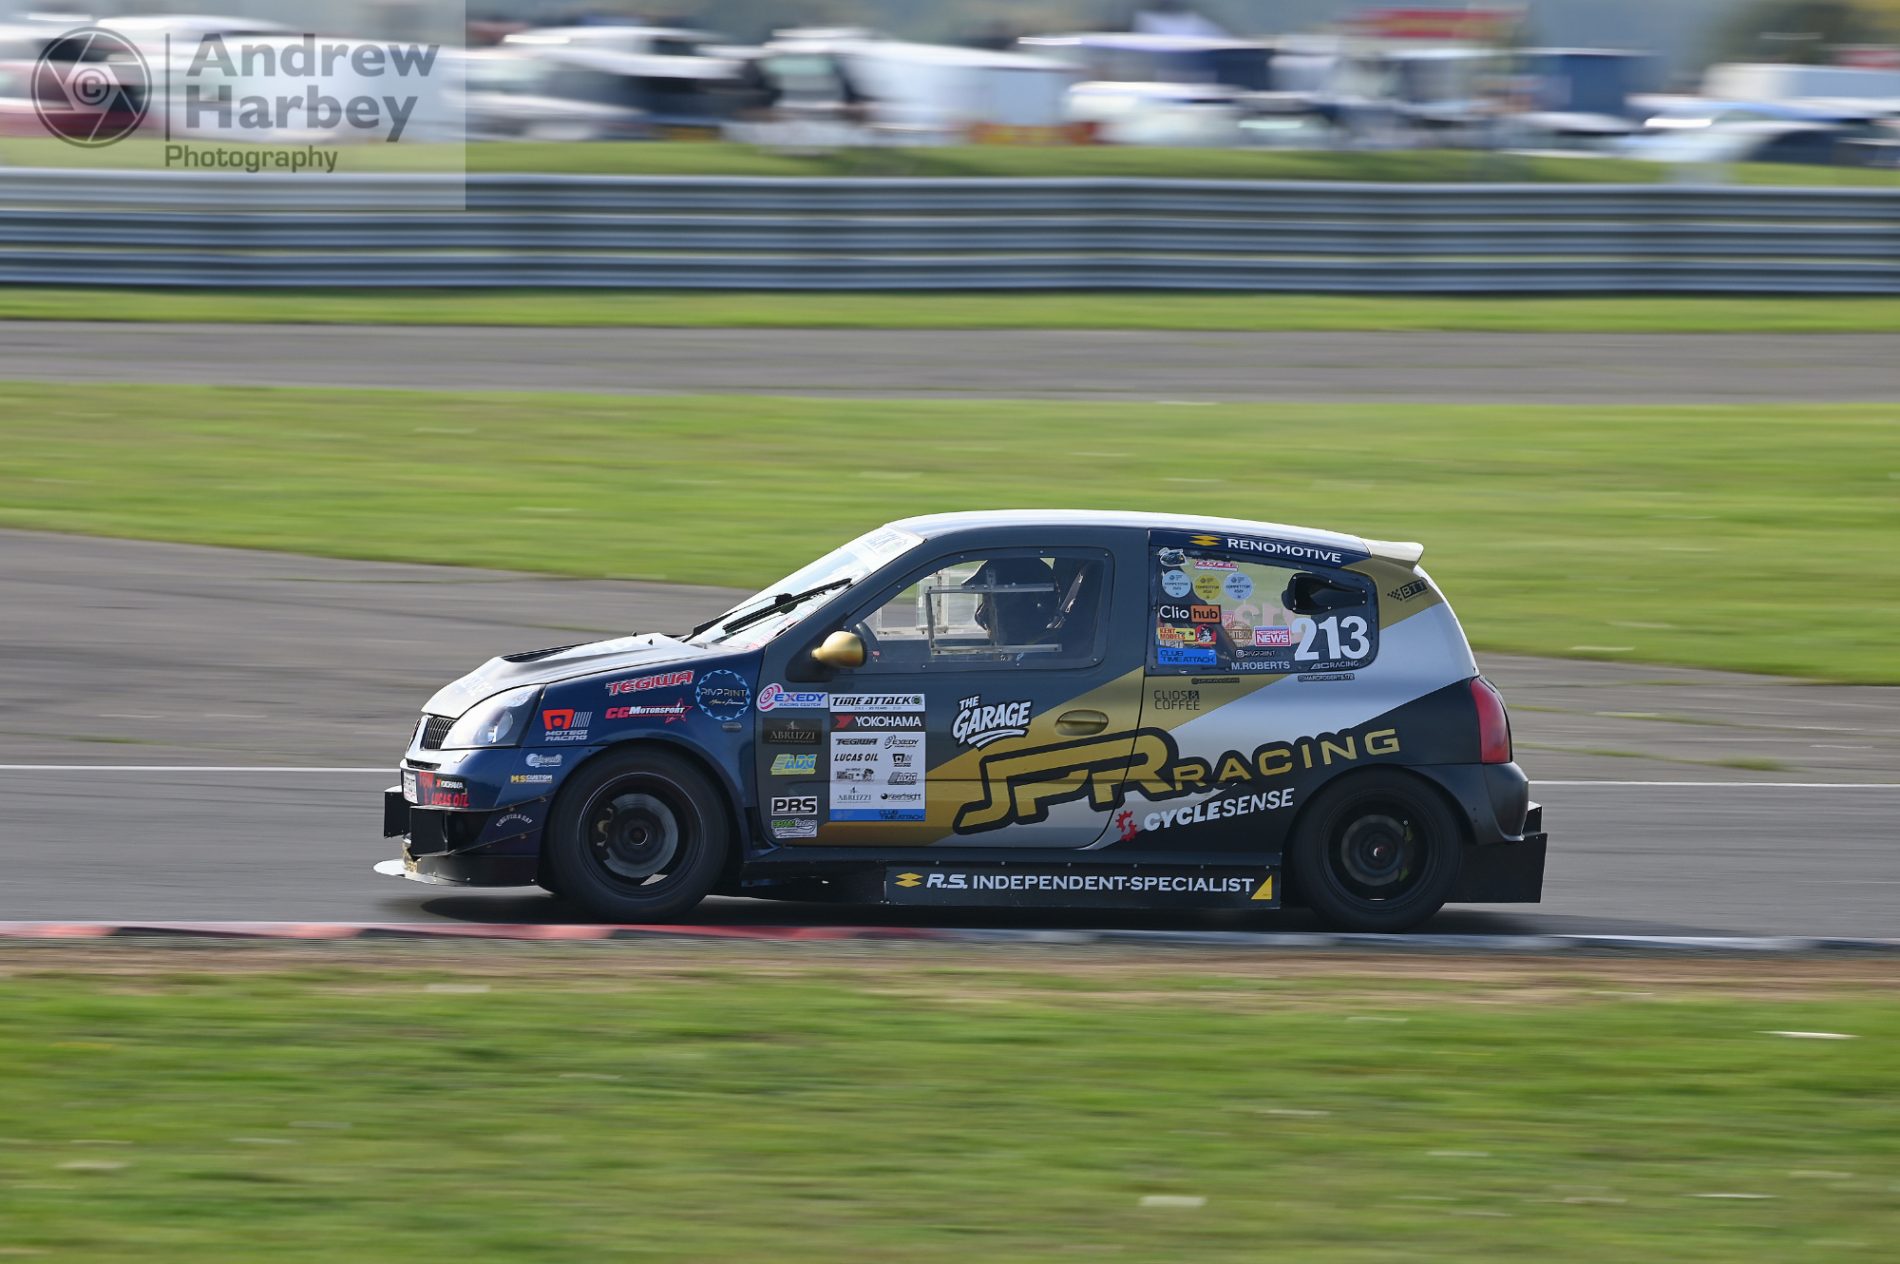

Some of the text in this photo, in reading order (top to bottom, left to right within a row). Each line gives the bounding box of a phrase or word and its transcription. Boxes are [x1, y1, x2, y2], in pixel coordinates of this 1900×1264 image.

[1227, 538, 1342, 563] RENOMOTIVE
[1160, 605, 1218, 619] Clio hub
[1256, 634, 1288, 643] NEWS
[1291, 616, 1370, 661] 213
[1231, 661, 1290, 670] M.ROBERTS
[605, 670, 694, 696] TEGIWA
[701, 687, 746, 697] RIVPRINT
[1154, 690, 1188, 700] CLIOS
[774, 694, 826, 702] EXEDY
[833, 696, 911, 706] TIME ATTACK
[959, 696, 980, 711] THE
[1155, 700, 1200, 710] COFFEE
[855, 716, 922, 727] YOKOHAMA
[953, 701, 1031, 744] GARAGE
[769, 731, 816, 740] ABRUZZI
[836, 738, 878, 746] TEGIWA
[834, 753, 878, 761] LUCAS OIL
[1172, 729, 1400, 791] RACING
[957, 734, 1178, 828] JPR
[1143, 788, 1295, 832] CYCLESENSE
[926, 873, 1254, 892] R.S. INDEPENDENT-SPECIALIST
